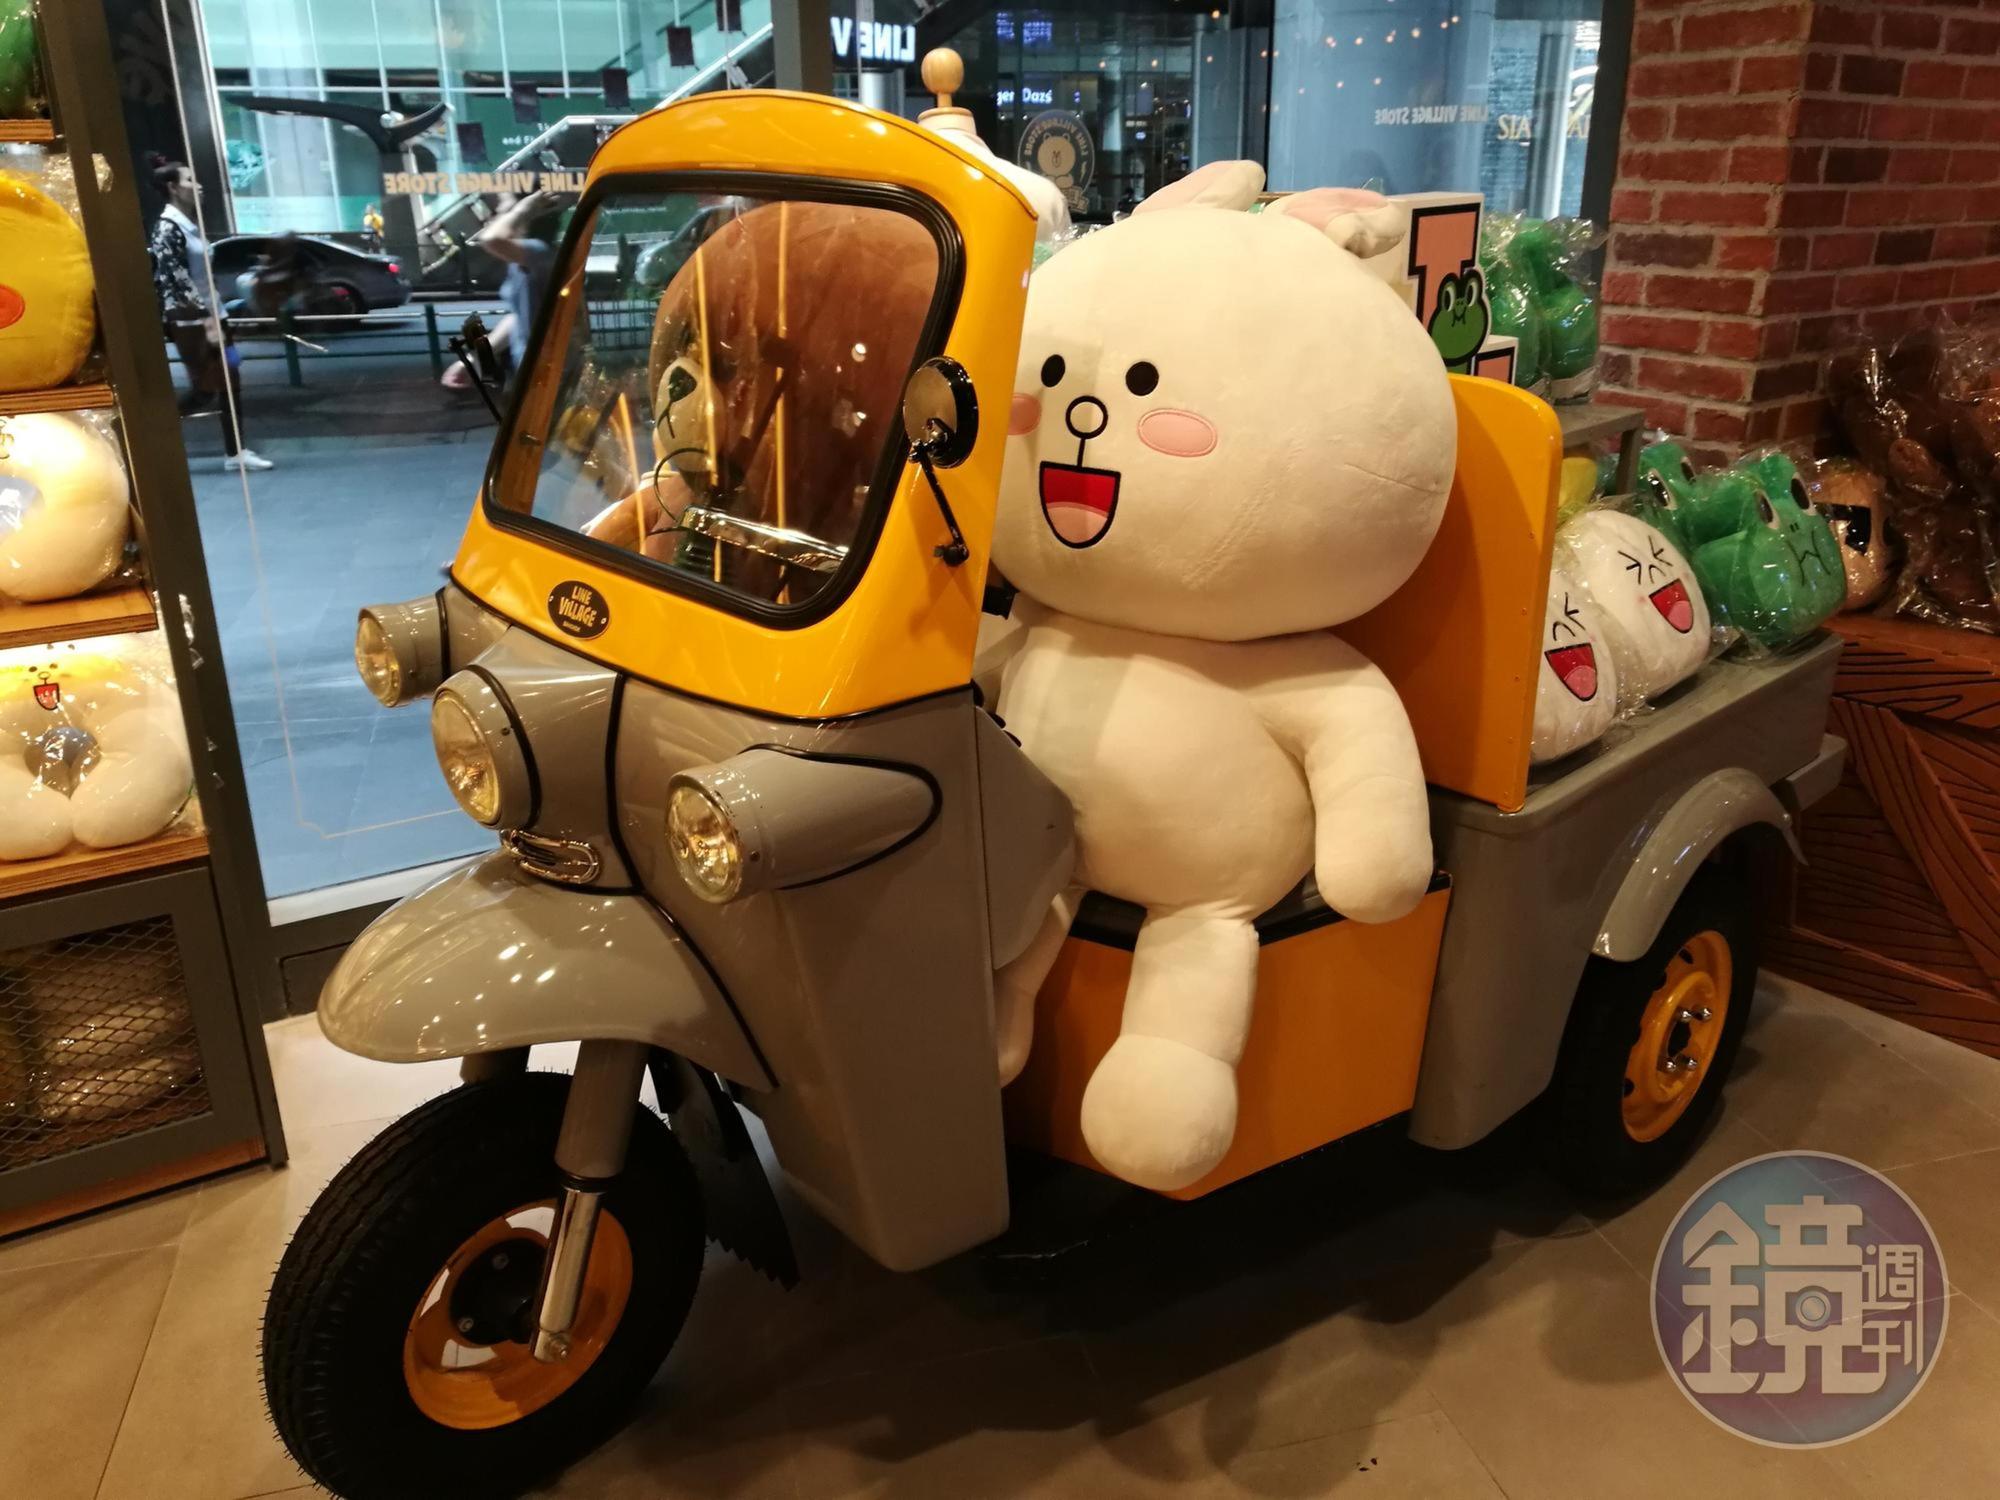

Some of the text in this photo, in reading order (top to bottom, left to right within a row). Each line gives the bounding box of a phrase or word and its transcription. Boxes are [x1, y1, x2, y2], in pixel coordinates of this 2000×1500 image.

[1497, 114, 1532, 140] SIA
[571, 585, 593, 606] LINE
[558, 596, 598, 627] VILLAGE
